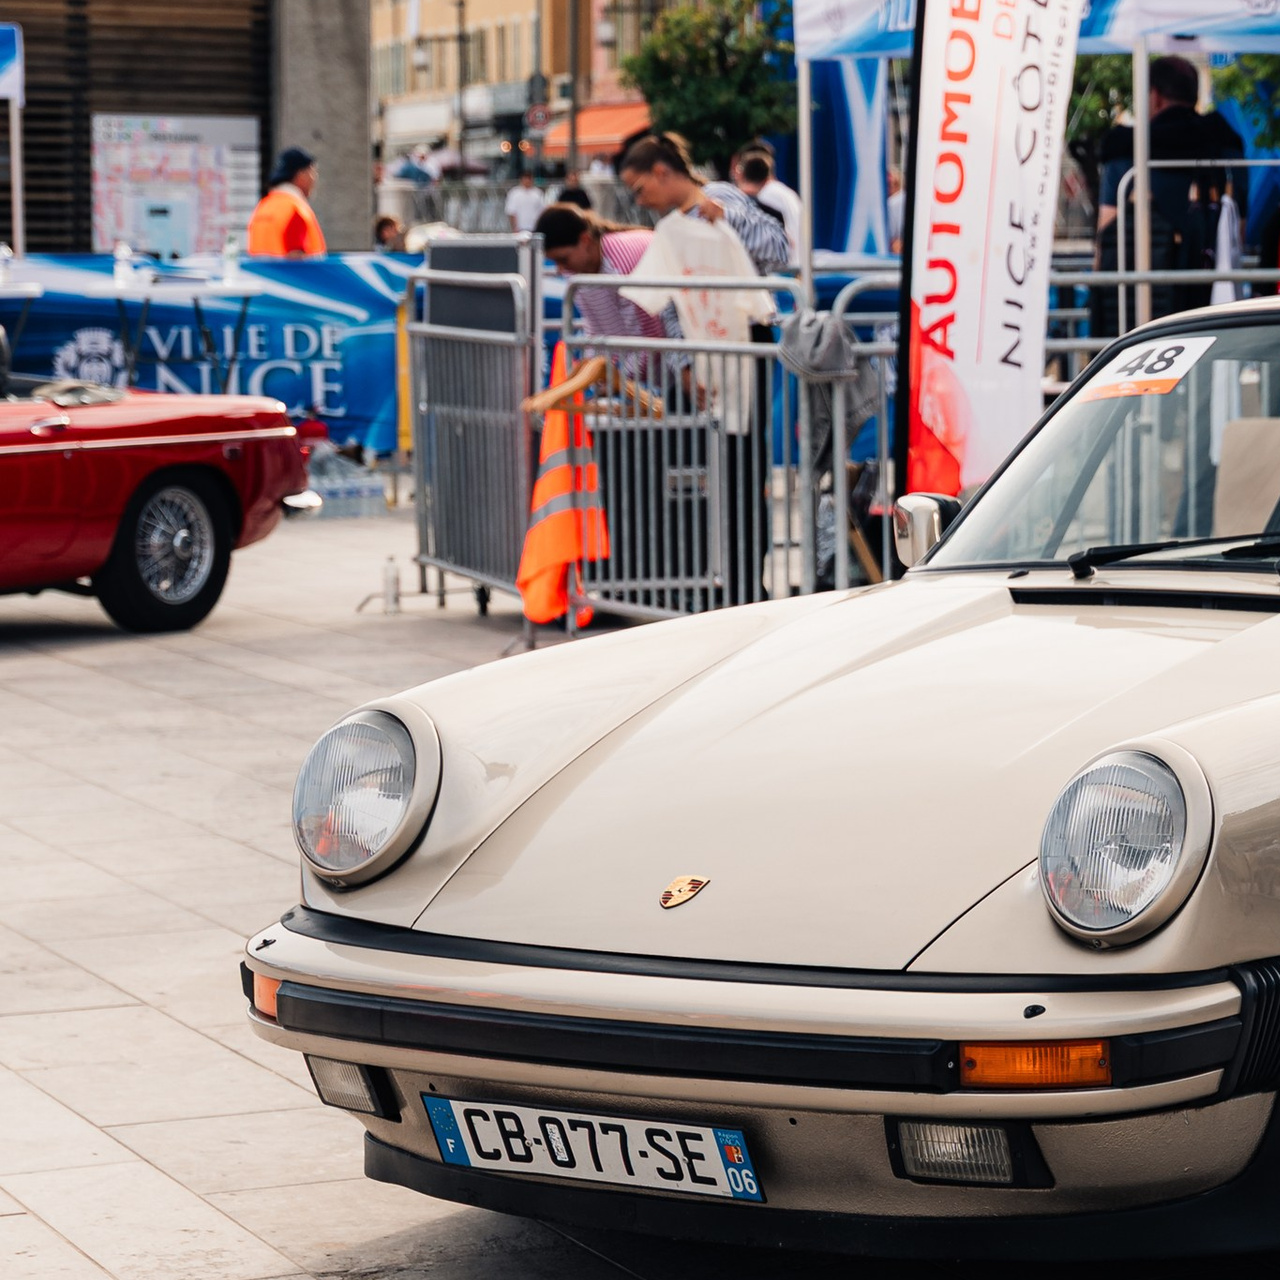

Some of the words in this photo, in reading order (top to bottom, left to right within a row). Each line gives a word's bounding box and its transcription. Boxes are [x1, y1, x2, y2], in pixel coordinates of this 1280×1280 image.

[283, 323, 344, 361] DE
[1115, 346, 1185, 376] 48
[155, 359, 346, 418] NICE
[445, 1137, 456, 1154] F
[463, 1108, 718, 1187] CB-077-SE
[727, 1167, 758, 1195] 06
